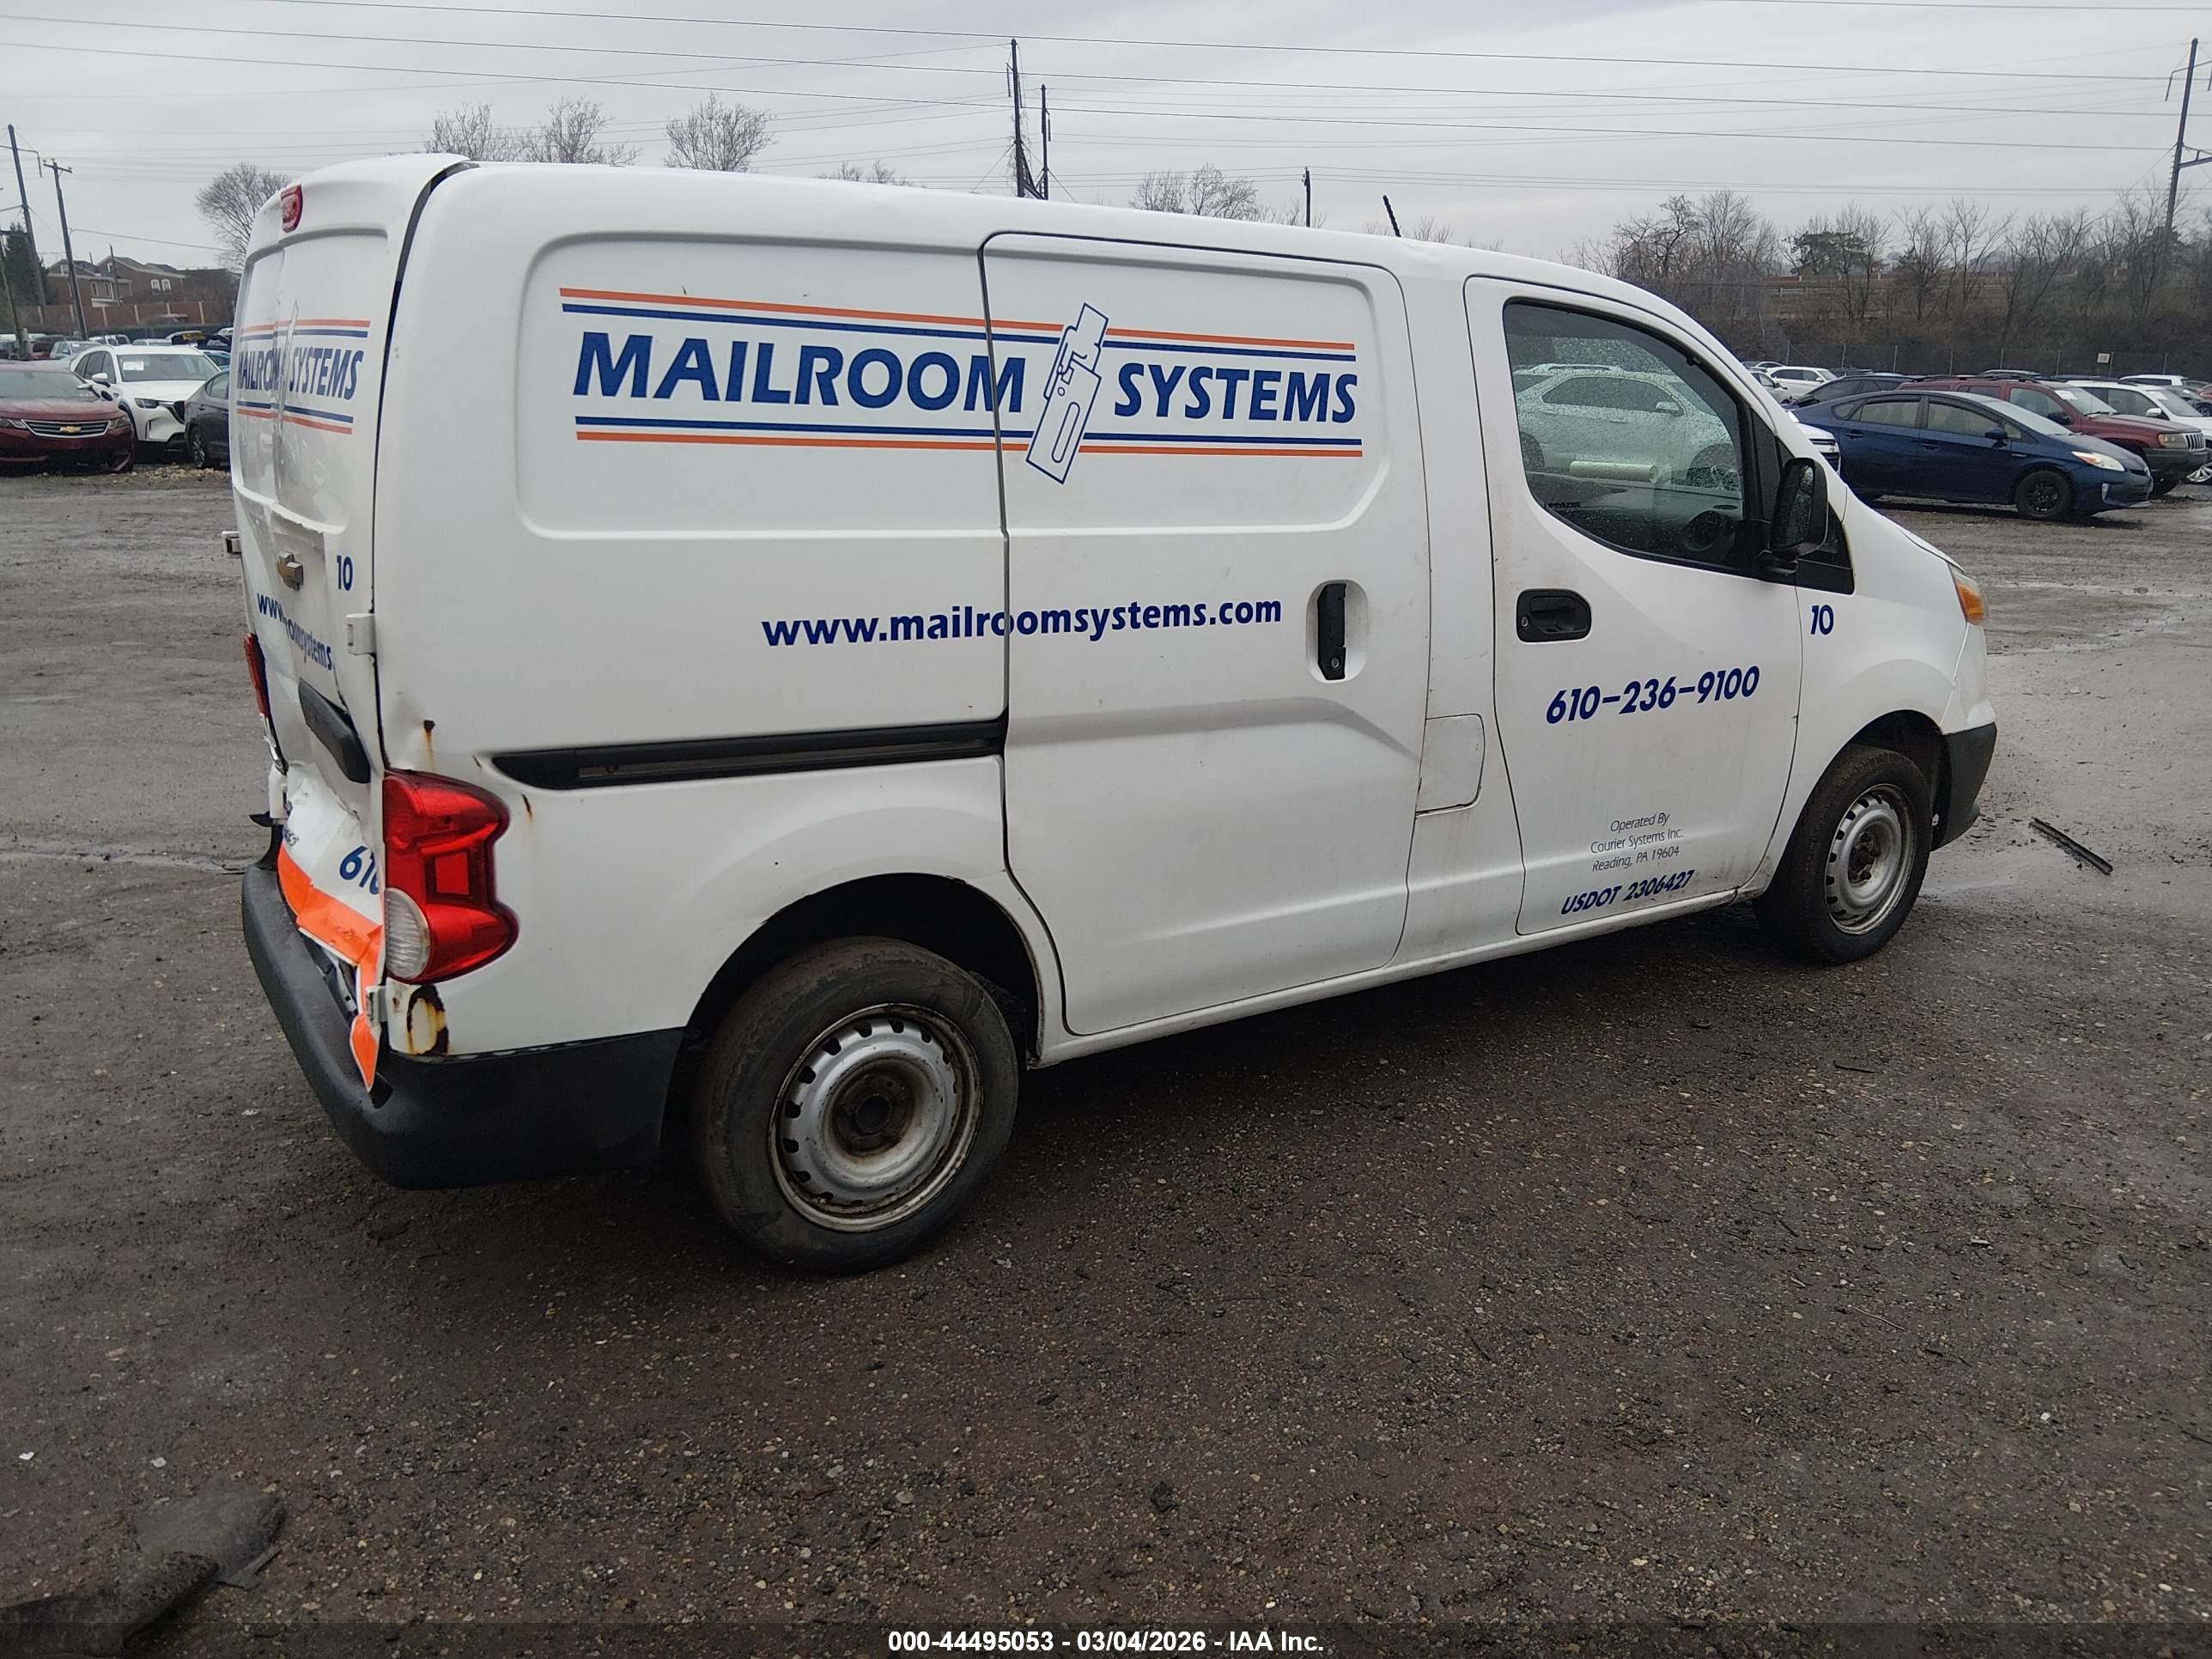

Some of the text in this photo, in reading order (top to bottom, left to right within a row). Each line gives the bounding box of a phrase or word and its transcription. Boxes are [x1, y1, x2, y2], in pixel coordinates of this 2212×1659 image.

[289, 347, 365, 401] SYSTEMS
[574, 331, 1358, 423] MAILROOM SYSTEMS
[337, 554, 354, 592] 10
[763, 601, 1282, 647] www.mailroomsystems.com
[1810, 605, 1834, 635] 10
[1546, 665, 1760, 724] 610-236-9100
[1590, 828, 1684, 854] Courier Systems Inc.
[1610, 812, 1669, 833] Operated By
[1592, 846, 1680, 872] Reading, PA 19604
[1560, 870, 1695, 915] USDOT 2306427
